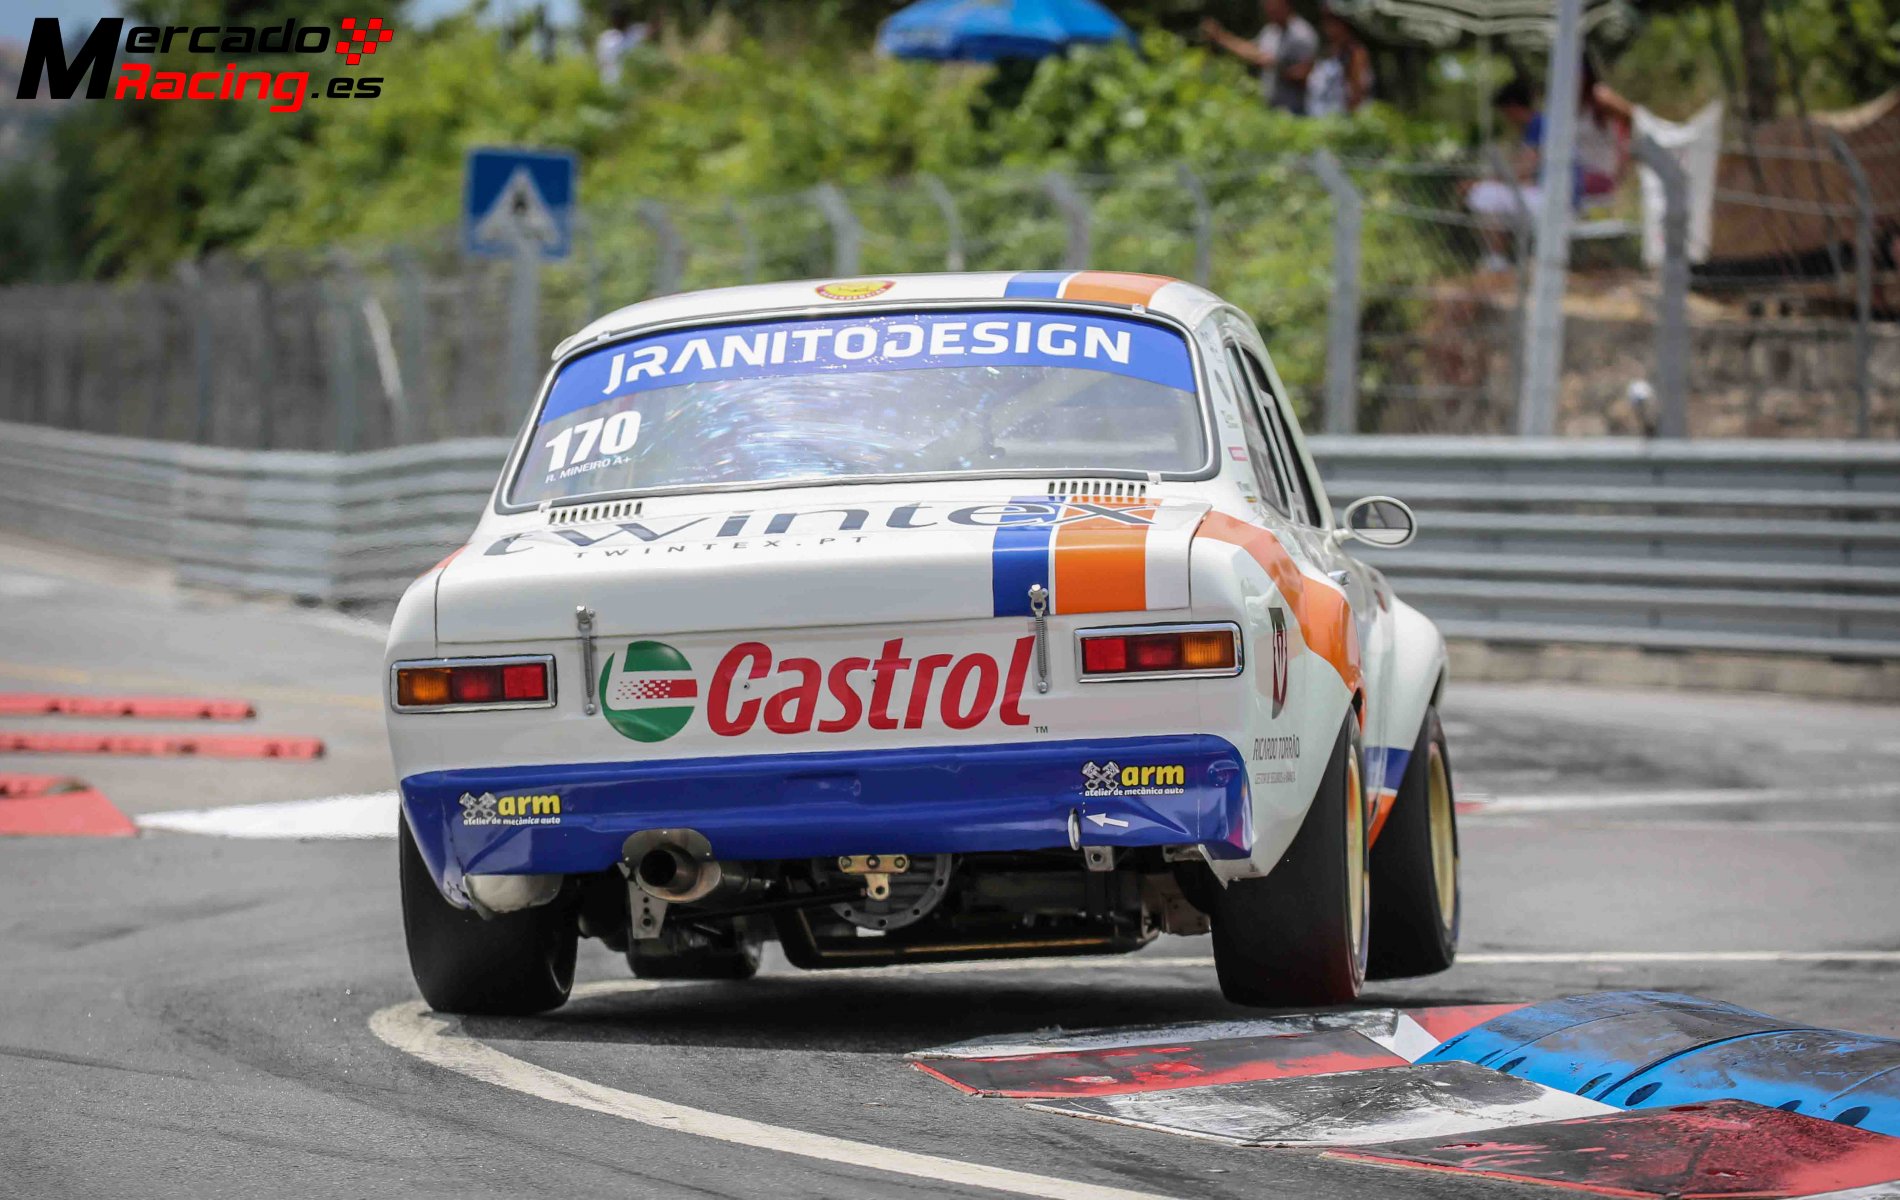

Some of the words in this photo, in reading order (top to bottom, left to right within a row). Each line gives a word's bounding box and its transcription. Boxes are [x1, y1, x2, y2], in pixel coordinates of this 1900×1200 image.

[545, 410, 641, 472] 170
[560, 458, 611, 479] MINEIRO
[612, 456, 632, 466] A+
[574, 535, 867, 559] TWINTEX.PT
[706, 635, 1036, 737] Castrol
[1252, 736, 1277, 760] RICARDO
[1121, 765, 1185, 787] arm
[1085, 787, 1112, 797] atelier
[1113, 786, 1123, 796] de
[1164, 787, 1184, 795] auto
[498, 794, 561, 816] arm
[463, 816, 490, 826] atelier
[491, 815, 501, 825] de
[540, 815, 561, 825] auto
